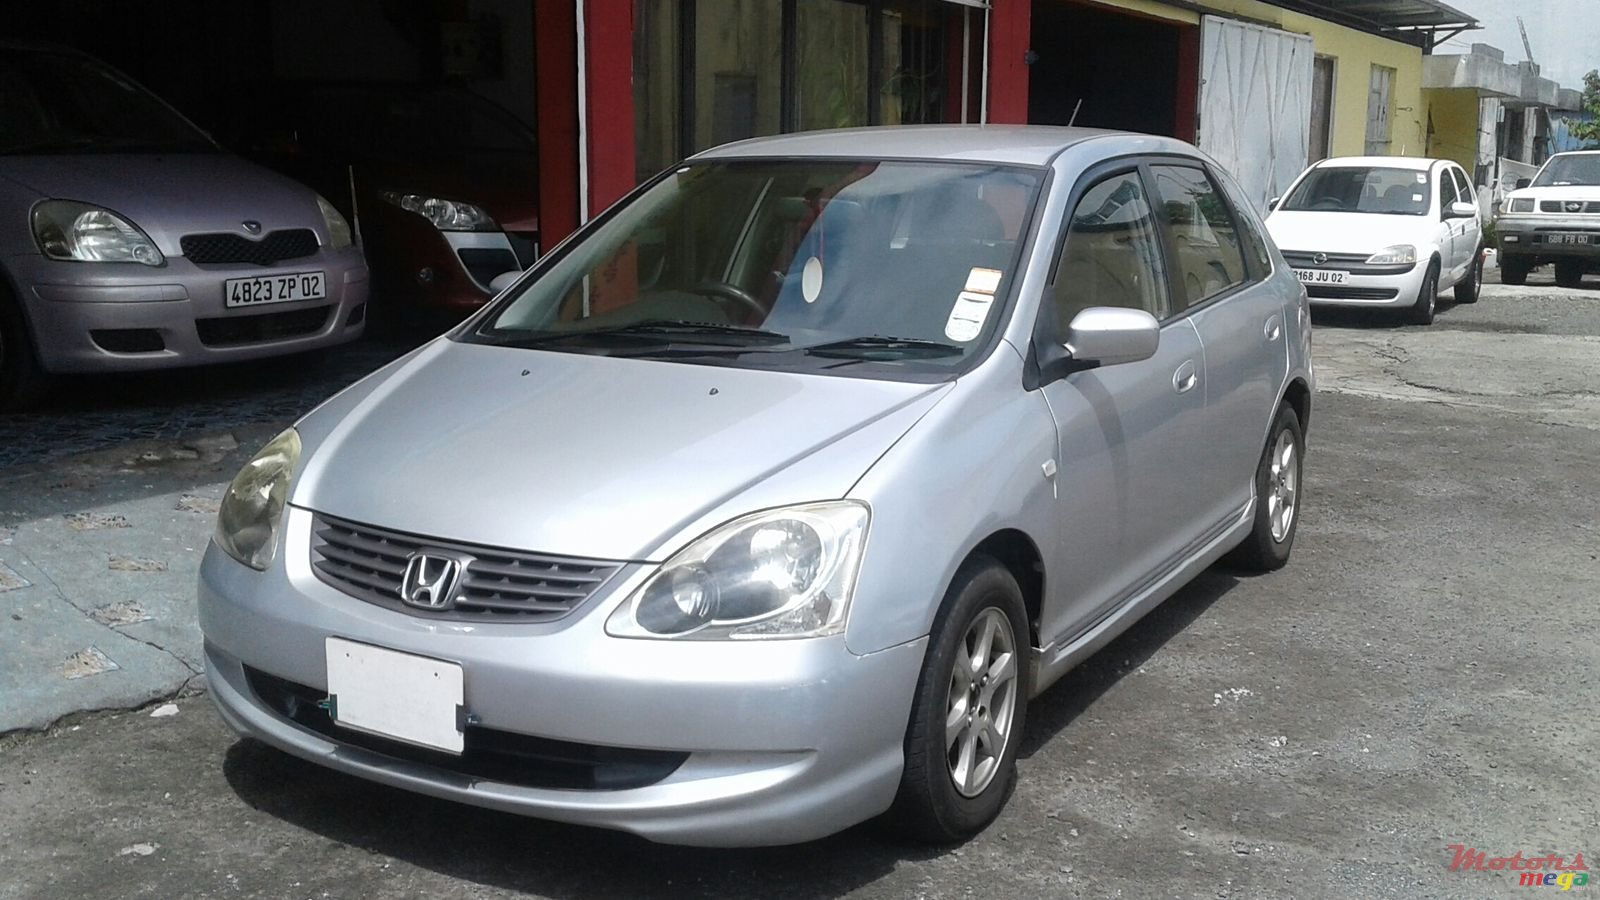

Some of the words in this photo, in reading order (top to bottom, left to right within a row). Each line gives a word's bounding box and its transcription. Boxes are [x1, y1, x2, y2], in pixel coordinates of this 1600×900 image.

[1316, 272, 1329, 282] JU
[1331, 273, 1343, 283] 02
[231, 280, 273, 304] 4823
[278, 278, 297, 299] ZP
[301, 276, 320, 297] 02
